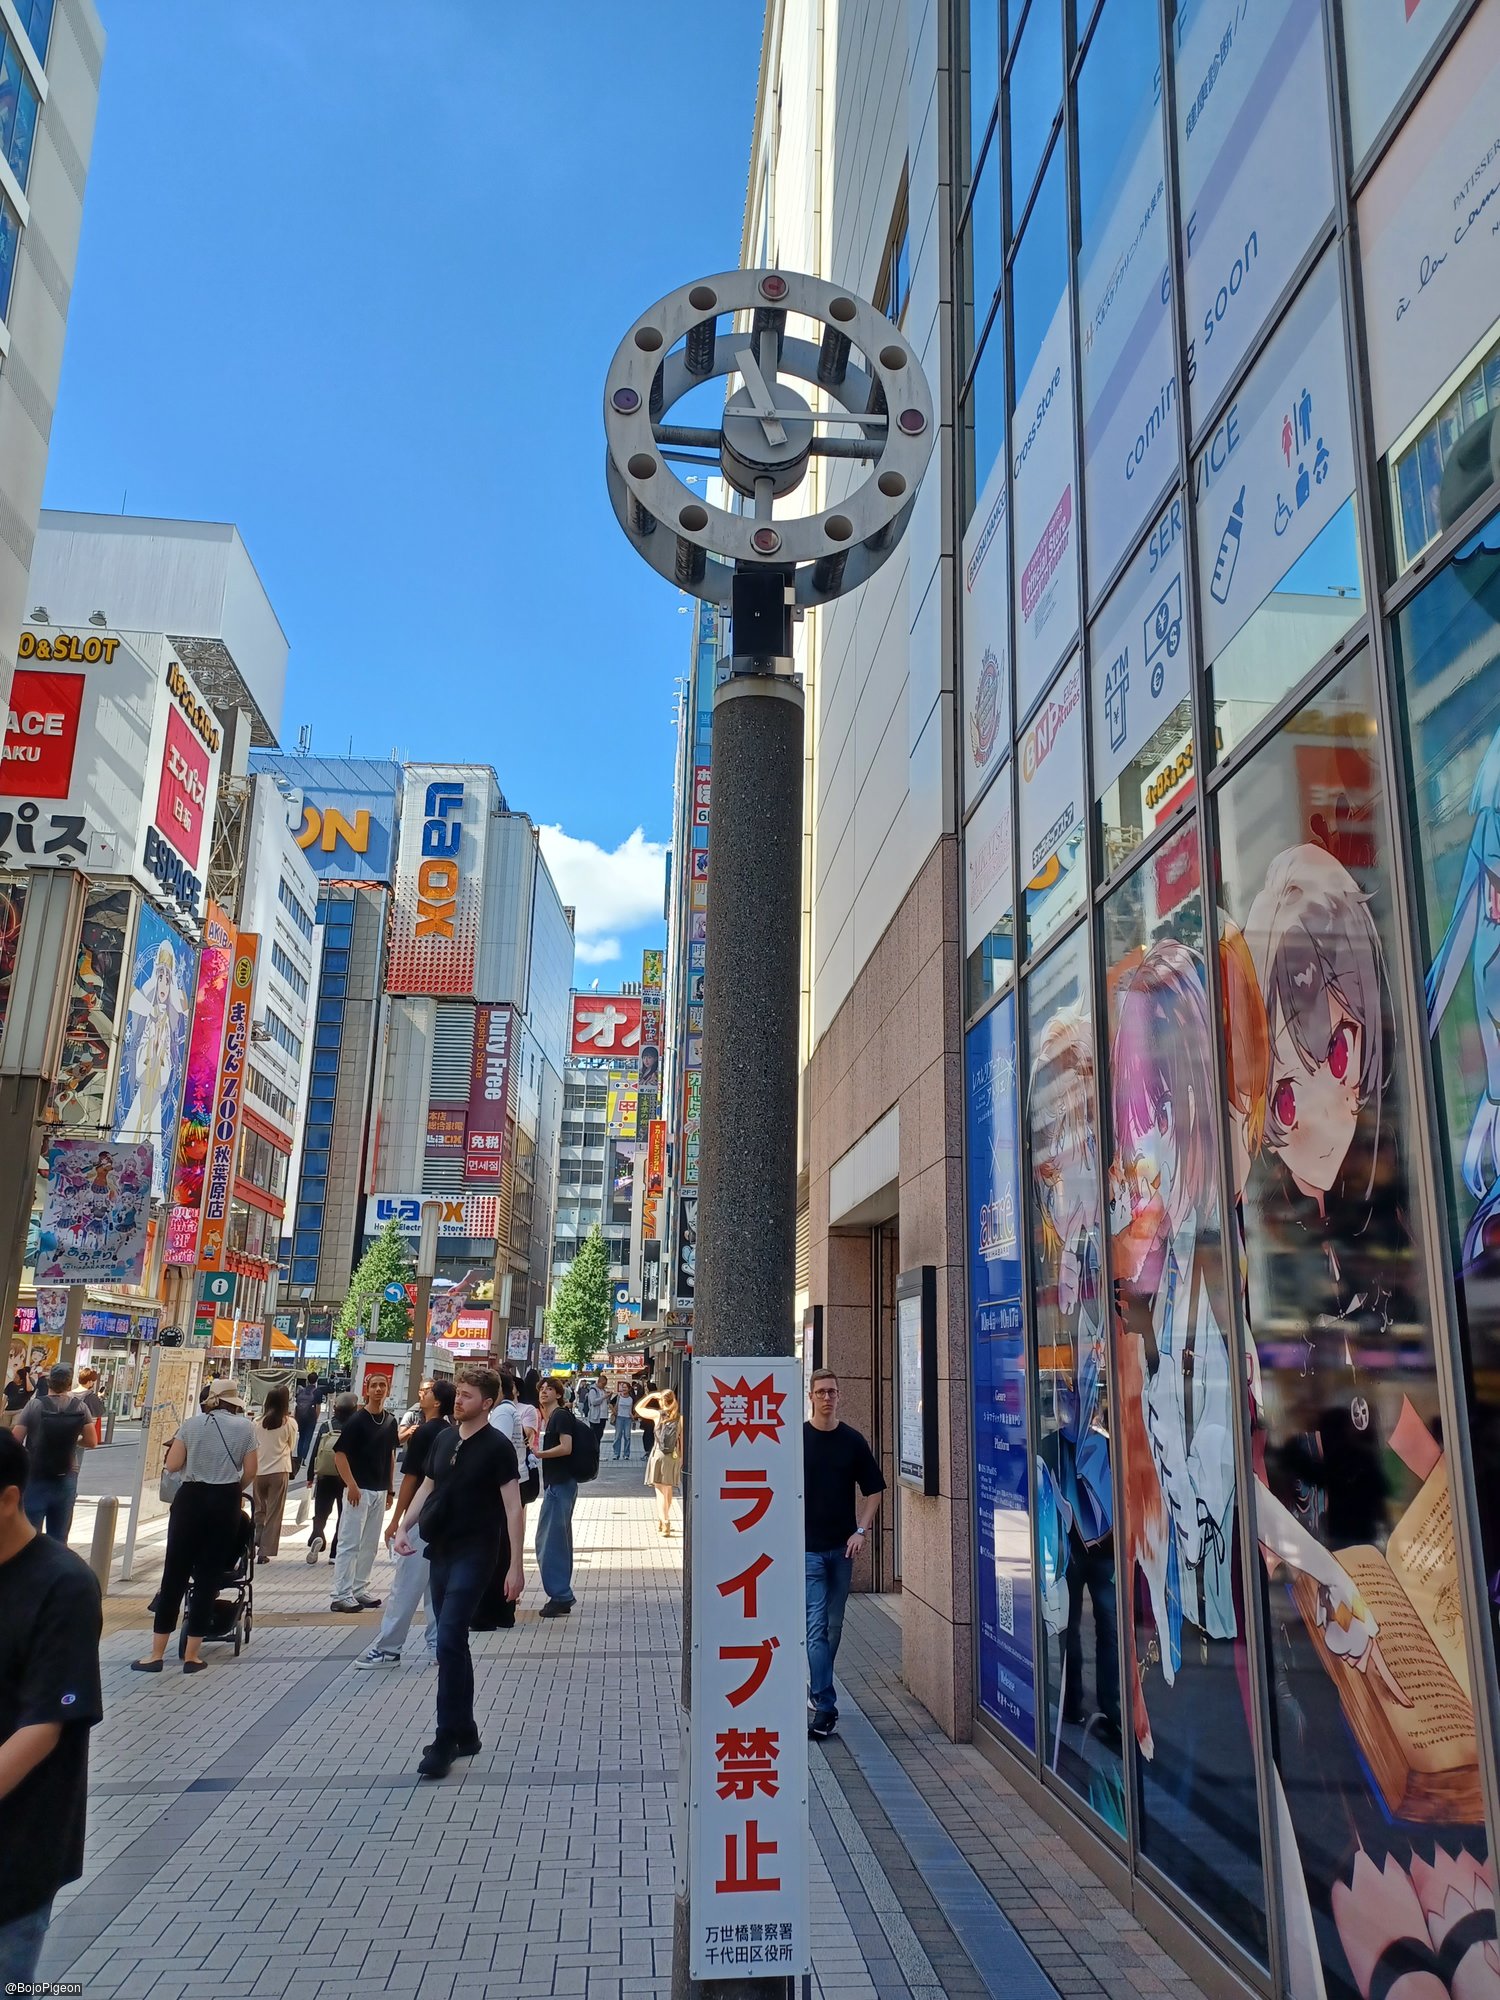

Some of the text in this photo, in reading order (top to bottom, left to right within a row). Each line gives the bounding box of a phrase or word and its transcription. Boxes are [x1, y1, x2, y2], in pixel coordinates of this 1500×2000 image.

[1204, 230, 1258, 345] soon
[1014, 366, 1061, 480] Cross Store
[1026, 551, 1048, 600] Official
[1049, 516, 1067, 552] Store
[1105, 646, 1129, 698] ATM
[143, 825, 202, 919] ESPACE
[236, 957, 251, 986] ZOO
[475, 1009, 488, 1078] Flagship Store
[484, 1010, 510, 1100] Duty Free
[206, 1001, 247, 1219] まぁじゃん ZOO 秋葉原店
[428, 1111, 447, 1121] 本店
[471, 1136, 500, 1150] 免税
[468, 1160, 499, 1172] 면세점
[443, 1224, 464, 1232] Store
[457, 1328, 488, 1339] OFF!!
[719, 1395, 778, 1426] 禁止
[714, 1469, 782, 1894] ライブ禁止
[705, 1923, 793, 1944] 万世橋警察署
[705, 1945, 793, 1966] 千代田区役所
